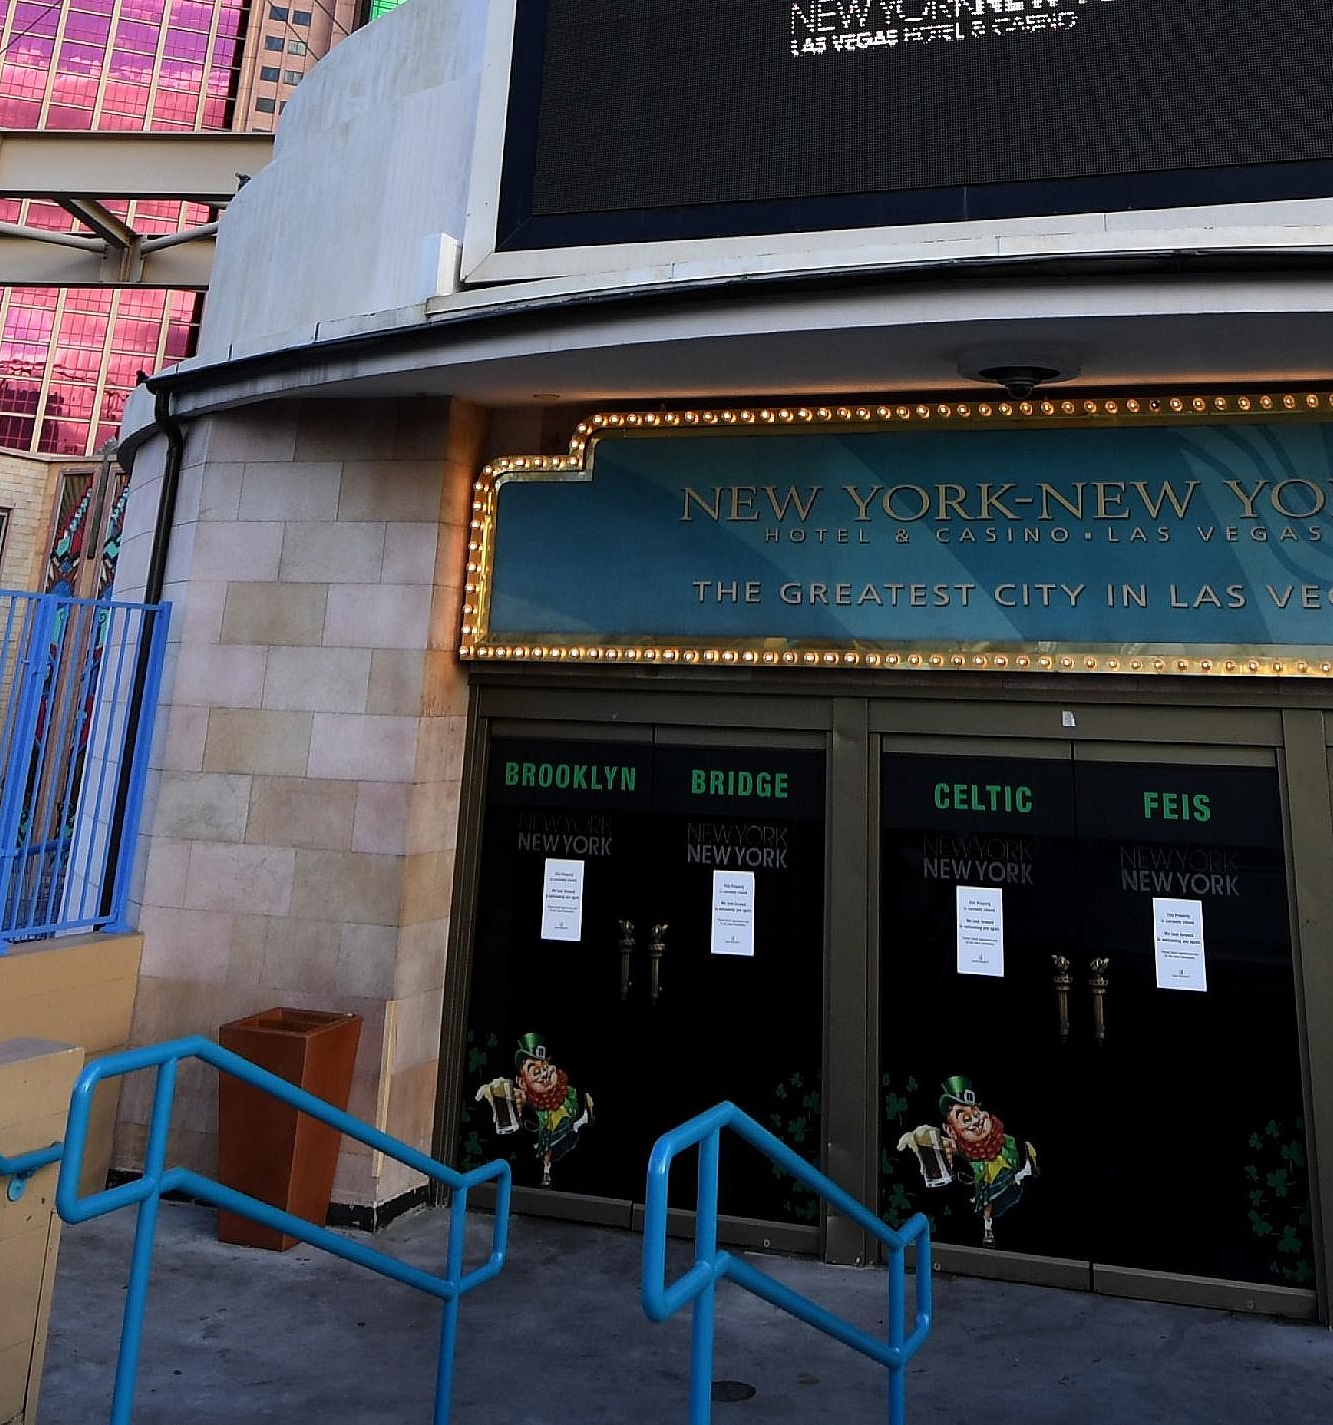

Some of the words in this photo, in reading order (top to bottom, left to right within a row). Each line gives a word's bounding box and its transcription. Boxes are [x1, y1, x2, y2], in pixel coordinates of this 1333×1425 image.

[790, 35, 828, 57] LAS
[832, 28, 899, 53] VEGAS
[679, 484, 823, 522] NEW
[764, 527, 870, 543] HOTEL
[895, 527, 910, 543] &
[936, 526, 1070, 543] CASINO
[1107, 526, 1171, 543] LAS
[1197, 525, 1324, 542] VEGAS
[692, 581, 762, 603] THE
[779, 582, 976, 607] GREATEST
[994, 583, 1085, 607] CITY
[1107, 583, 1148, 607] IN
[1169, 583, 1246, 608] LAS
[504, 761, 636, 791] BROOKLYN
[690, 769, 789, 798] BRIDGE
[933, 782, 1034, 813] CELTIC
[1141, 791, 1212, 822] FEIS
[518, 832, 564, 852] NEW
[560, 834, 612, 856] YORK
[687, 844, 735, 865] NEW
[731, 846, 788, 869] YORK
[923, 858, 976, 880] NEW
[972, 860, 1035, 885] YORK
[1121, 870, 1175, 893] NEW
[1171, 872, 1240, 897] YORK
